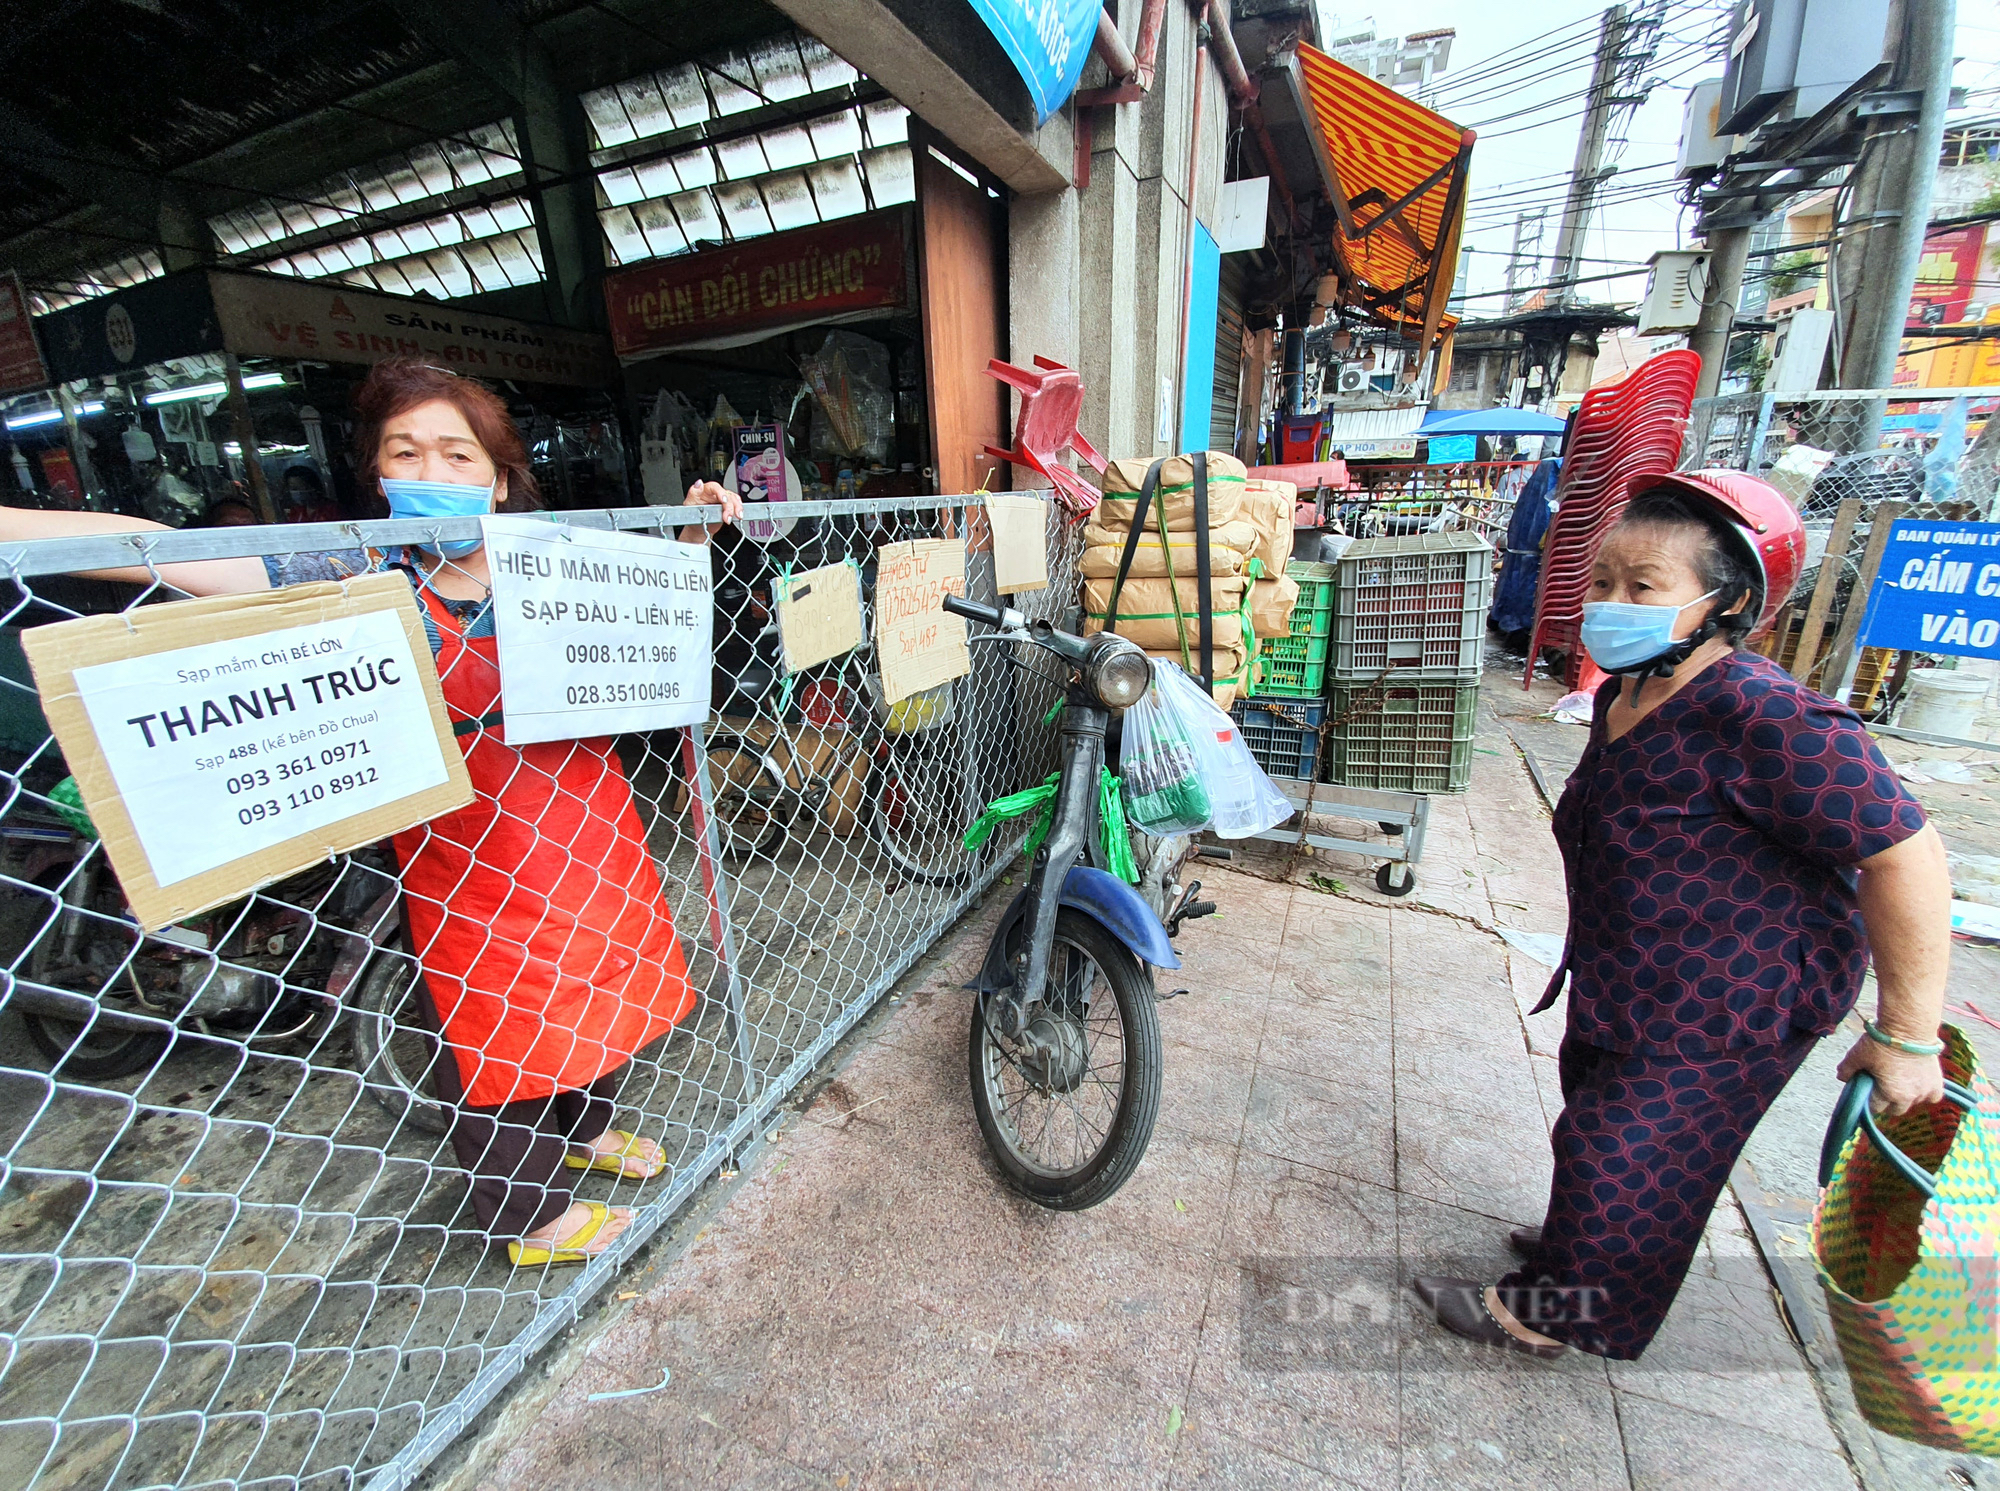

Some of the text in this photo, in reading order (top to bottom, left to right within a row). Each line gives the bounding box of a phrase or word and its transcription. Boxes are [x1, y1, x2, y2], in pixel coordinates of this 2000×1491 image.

[384, 311, 454, 335] SẢN
[461, 325, 545, 348] PHẨM
[740, 431, 775, 444] CHIN-SU
[1895, 528, 2000, 546] BAN QUẢN LÝ
[494, 551, 709, 593] HIỆU MẮM HỒNG LIÊN
[1900, 549, 2000, 597] CẤM C
[521, 599, 568, 625] SẠP
[575, 599, 617, 623] ĐẦU
[635, 603, 669, 626] LIÊN
[673, 608, 700, 630] HỆ:
[1921, 609, 2000, 648] VÀO
[566, 644, 677, 663] 0908.121.966
[918, 624, 938, 652] 487
[177, 637, 344, 686] Sạp mắm Chị BÉ LỚN
[127, 655, 402, 748] THANH TRÚC
[566, 682, 680, 705] 028.35100496
[194, 709, 380, 773] Sạp 488 (kế bên Đồ Chua)
[226, 738, 372, 795] 093 361 0971
[237, 766, 380, 827] 093 110 8912
